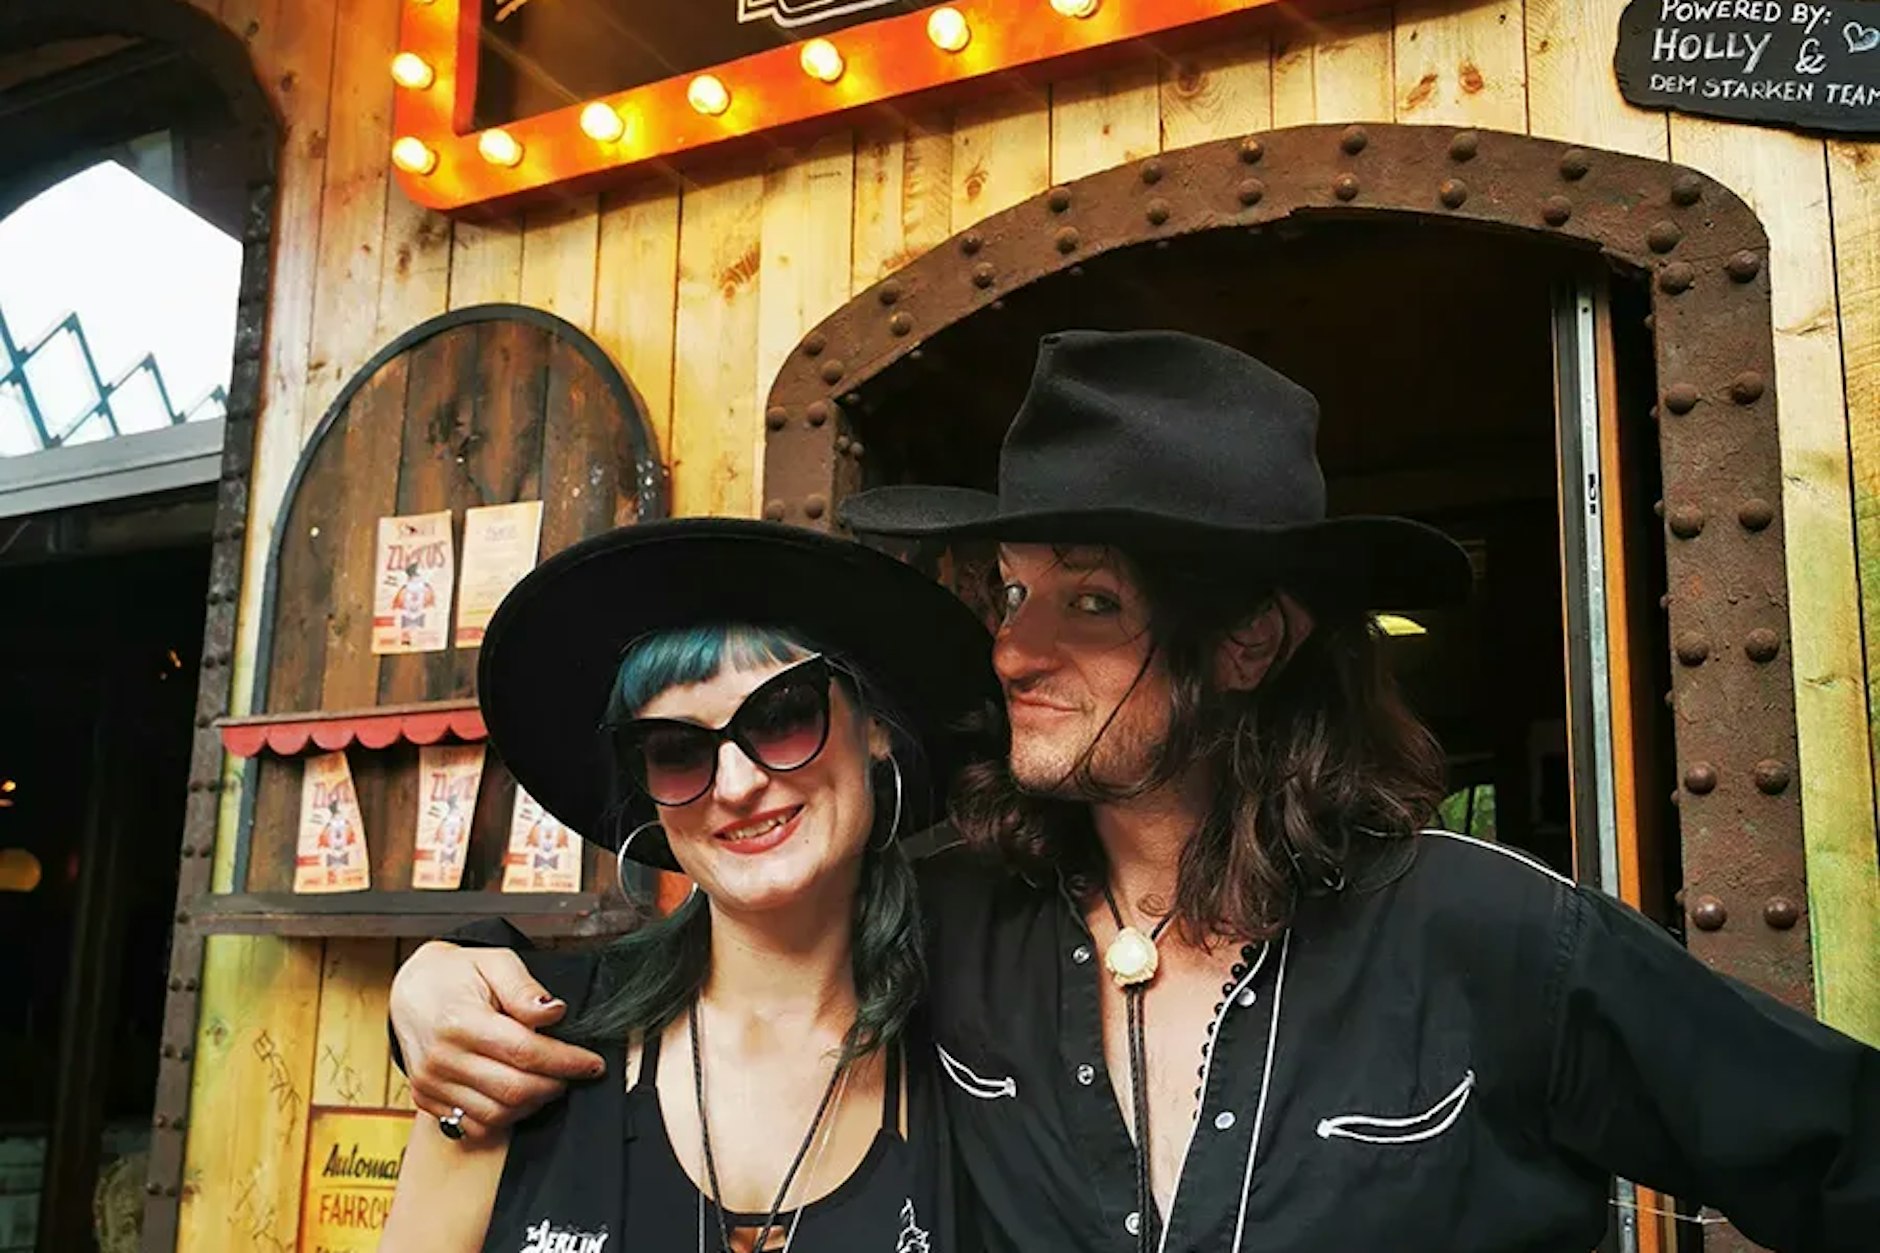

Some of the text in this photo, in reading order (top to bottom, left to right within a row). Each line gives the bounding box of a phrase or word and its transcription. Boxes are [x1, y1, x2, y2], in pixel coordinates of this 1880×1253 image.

[1661, 0, 1832, 34] POWERED BY:
[1652, 28, 1827, 74] HOLLY &
[1650, 74, 1697, 94] DEM
[1702, 79, 1814, 102] STARKEN
